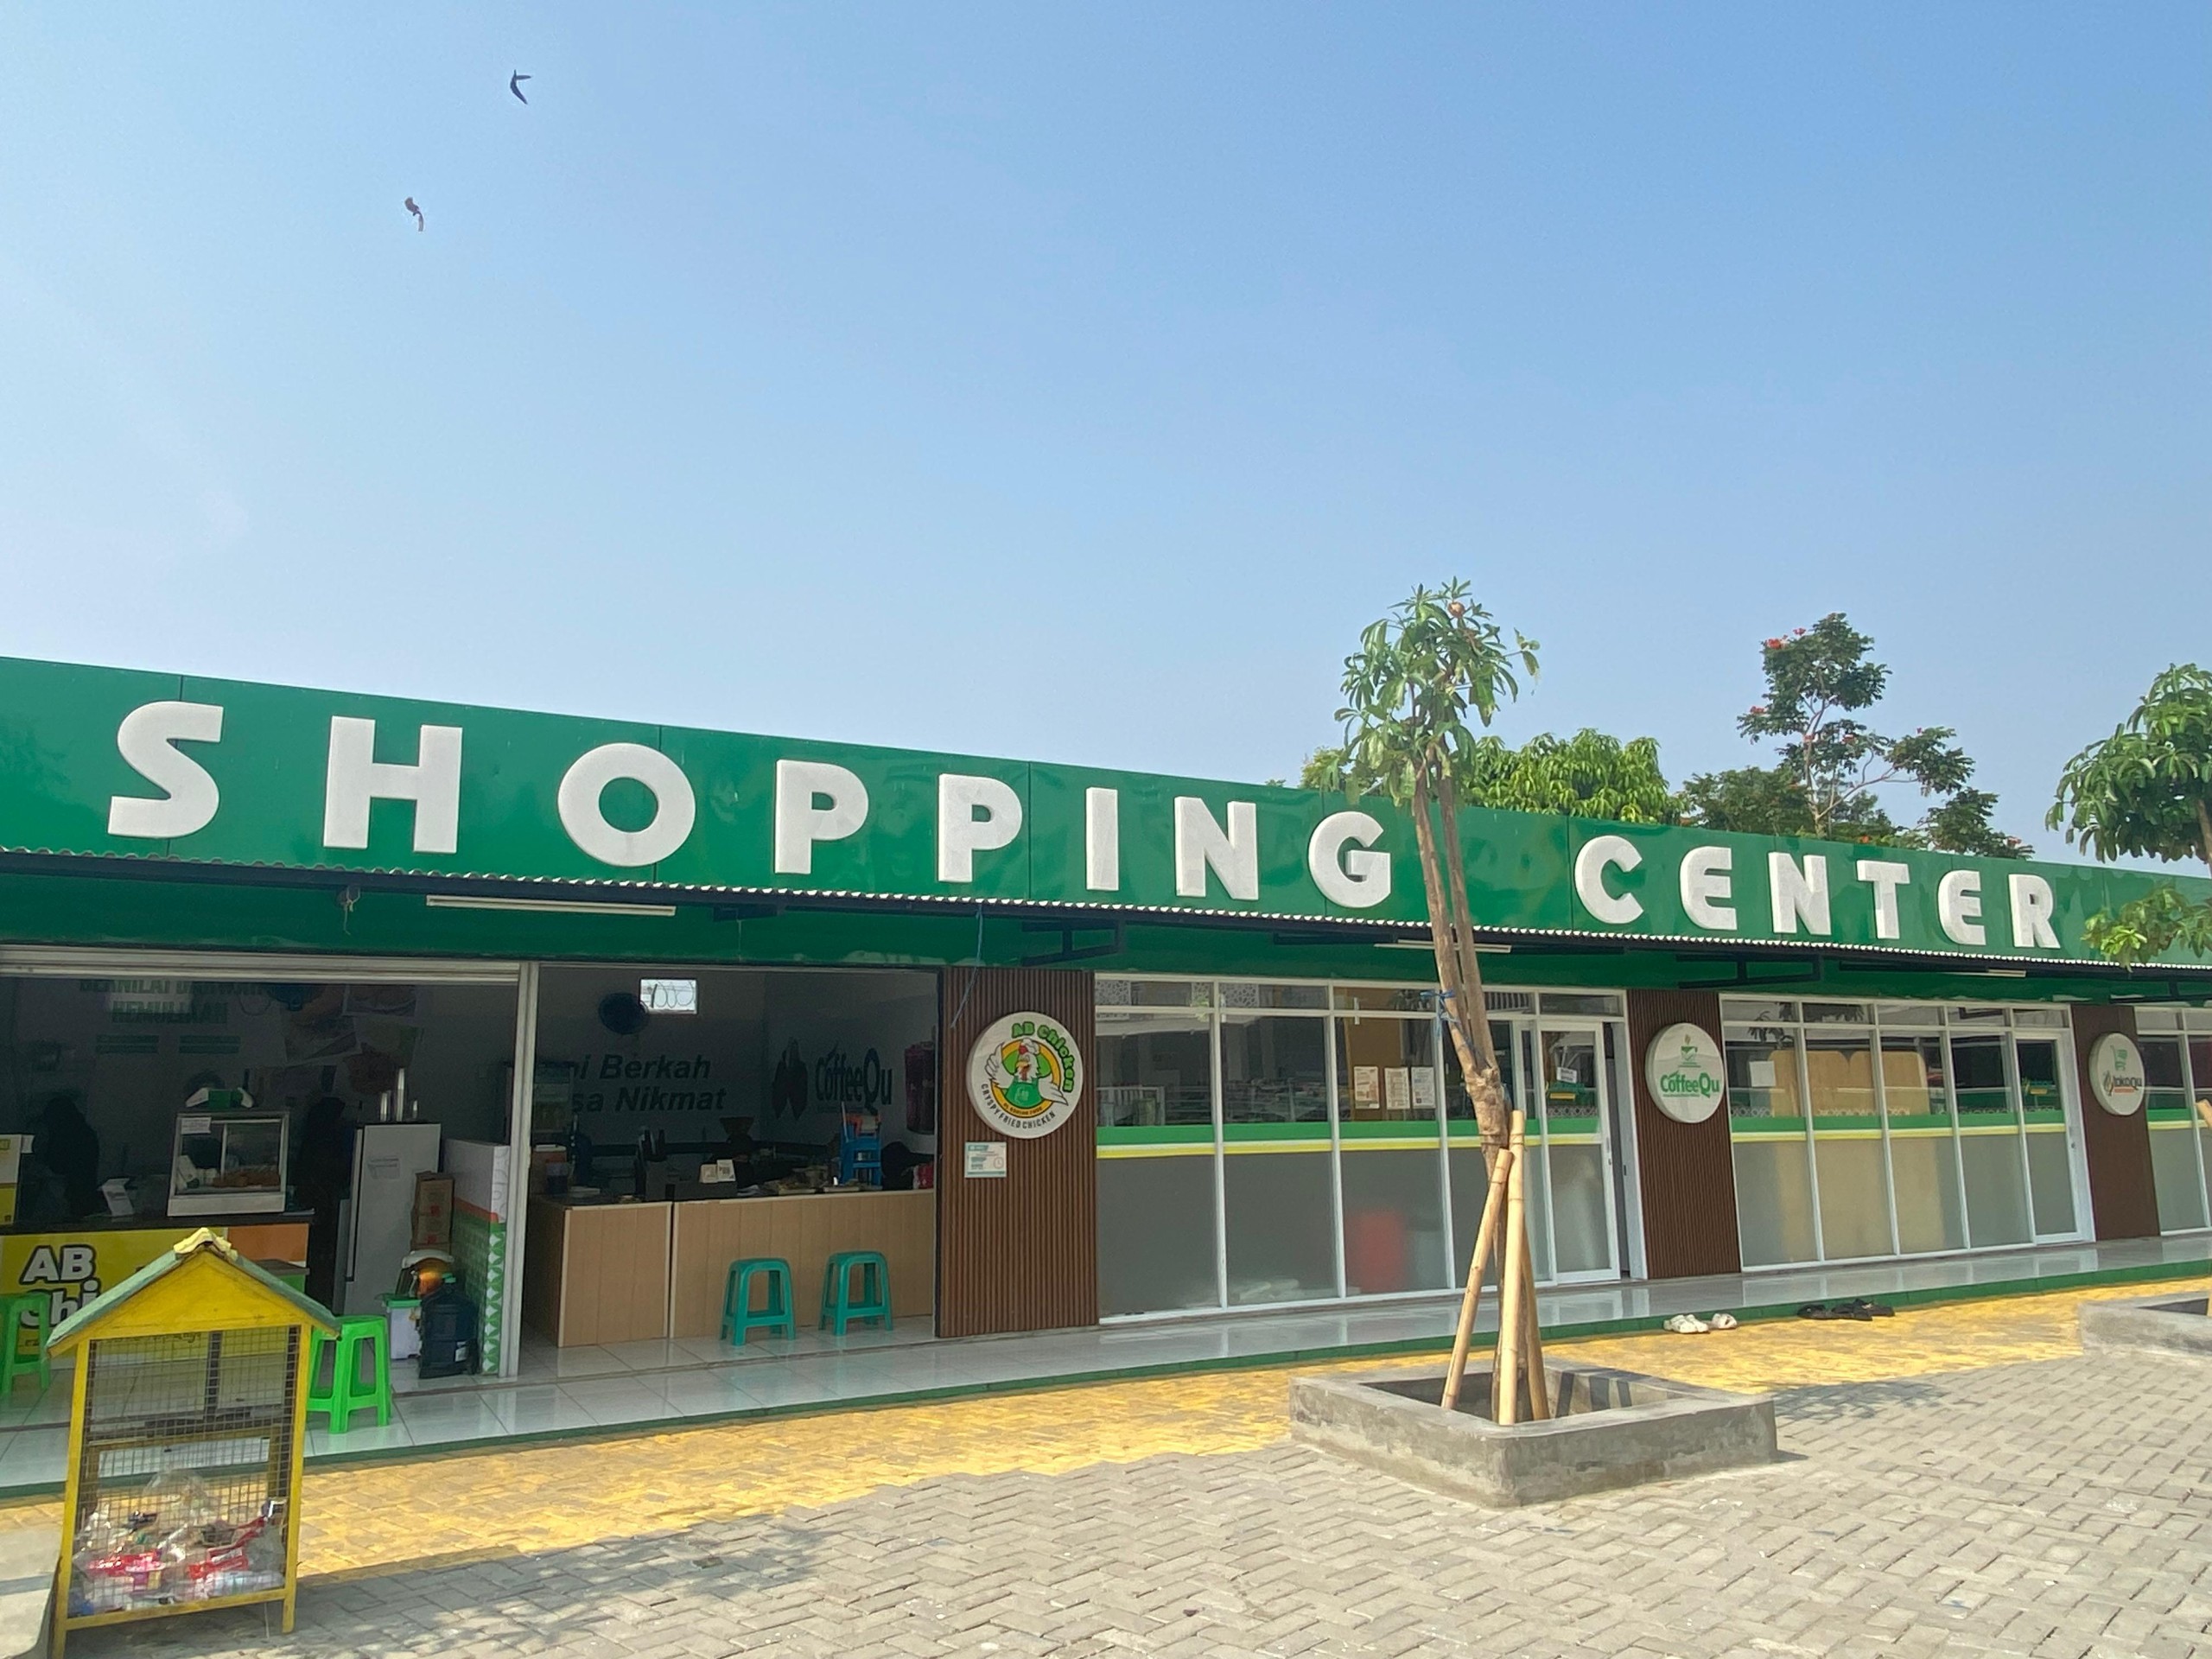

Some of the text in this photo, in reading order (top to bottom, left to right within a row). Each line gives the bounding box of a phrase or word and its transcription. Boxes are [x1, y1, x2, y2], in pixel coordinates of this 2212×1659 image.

[108, 701, 2061, 949] SHOPPING CENTER
[600, 1054, 711, 1080] Berkah
[815, 1042, 893, 1115] CoffeeQu
[614, 1085, 728, 1112] Nikmat
[1660, 1071, 1720, 1098] CoffeeQu
[19, 1244, 98, 1285] AB
